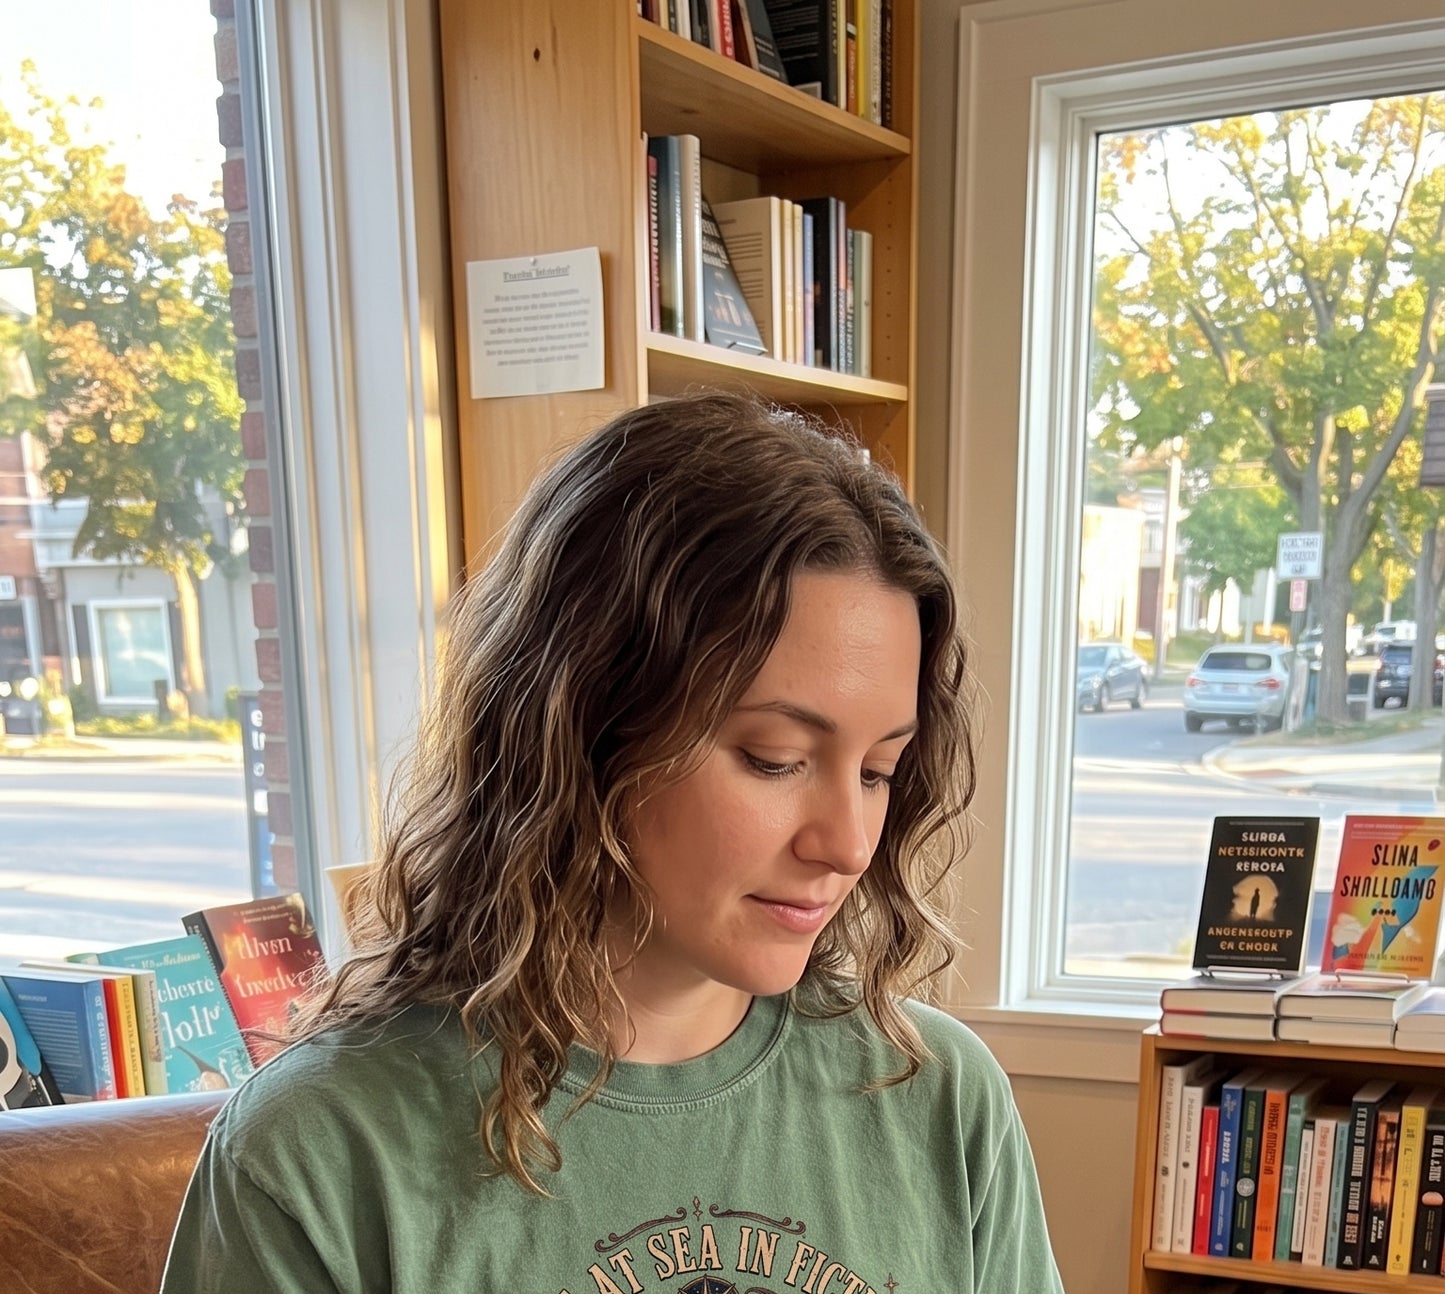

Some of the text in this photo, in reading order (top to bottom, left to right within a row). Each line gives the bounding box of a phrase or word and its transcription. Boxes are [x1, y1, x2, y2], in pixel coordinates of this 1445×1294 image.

[1371, 844, 1418, 867] SLINA
[647, 1223, 724, 1281] SEA
[735, 1225, 781, 1278] IN
